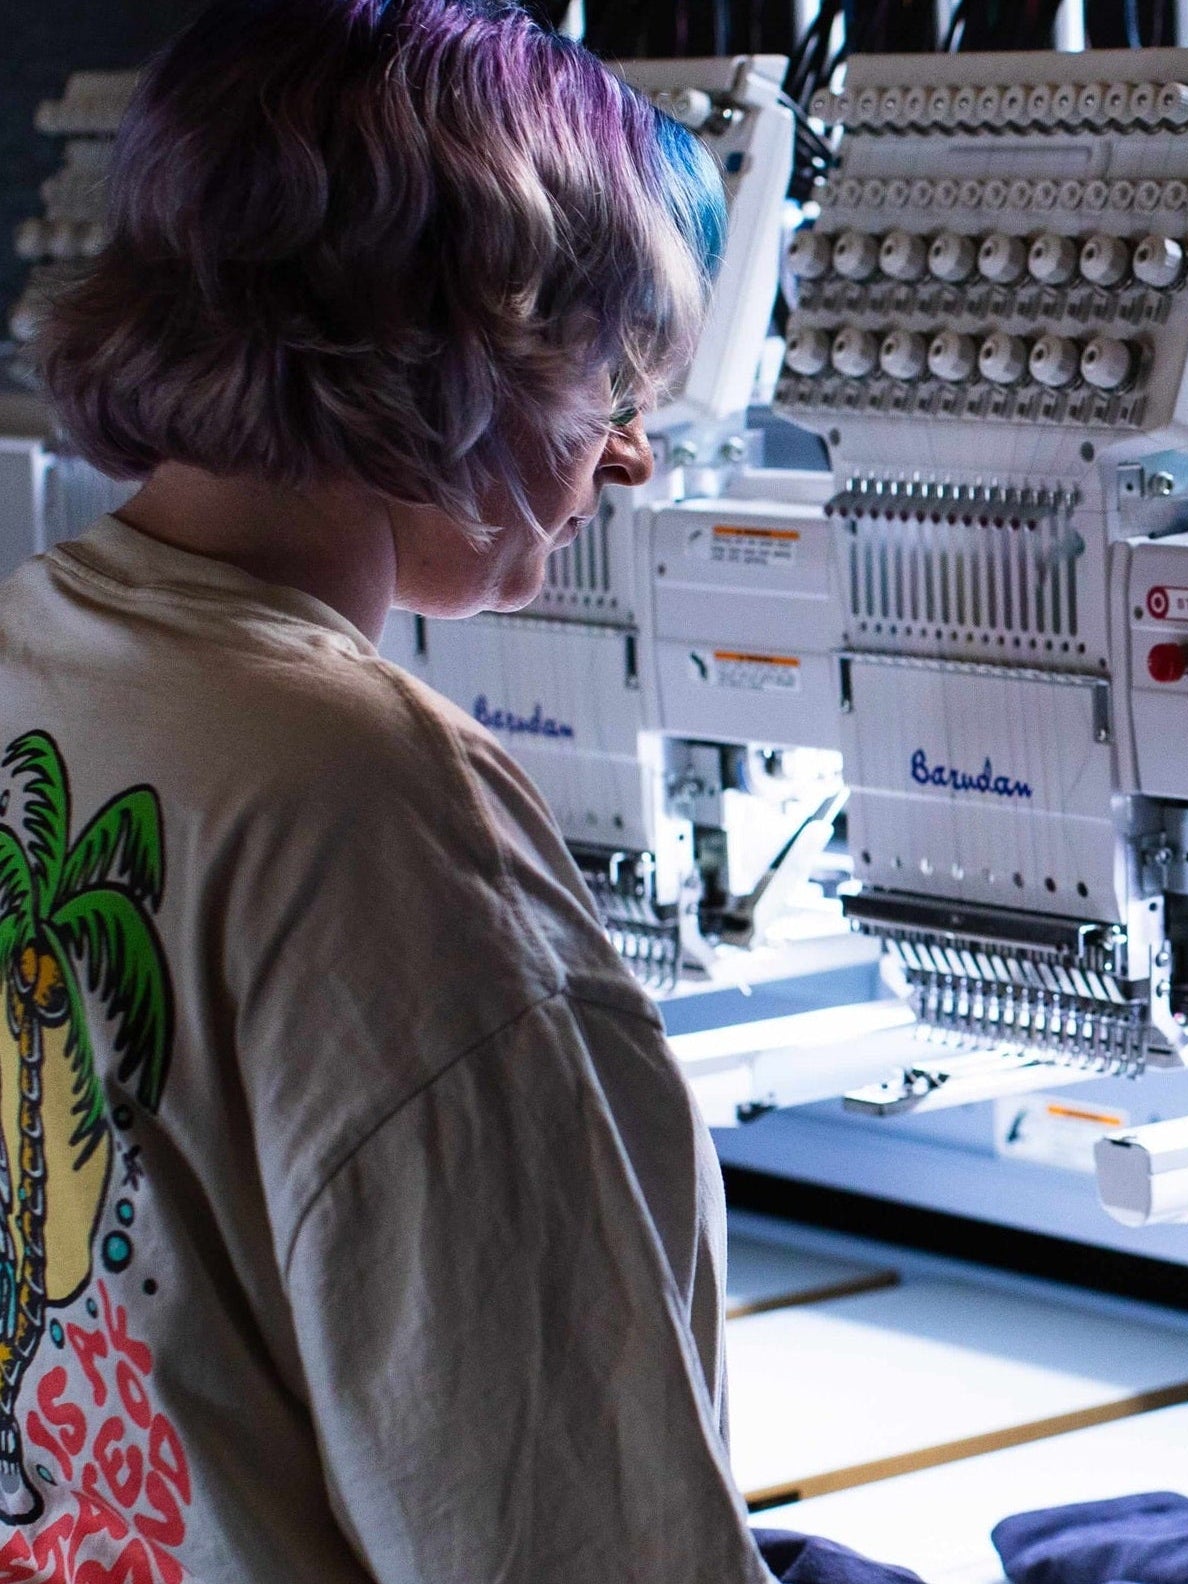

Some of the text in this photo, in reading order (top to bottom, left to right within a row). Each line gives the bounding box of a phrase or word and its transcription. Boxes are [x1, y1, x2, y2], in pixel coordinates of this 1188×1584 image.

[473, 692, 574, 737] Barudan
[911, 749, 1032, 798] Barudan
[26, 1366, 87, 1482] IS
